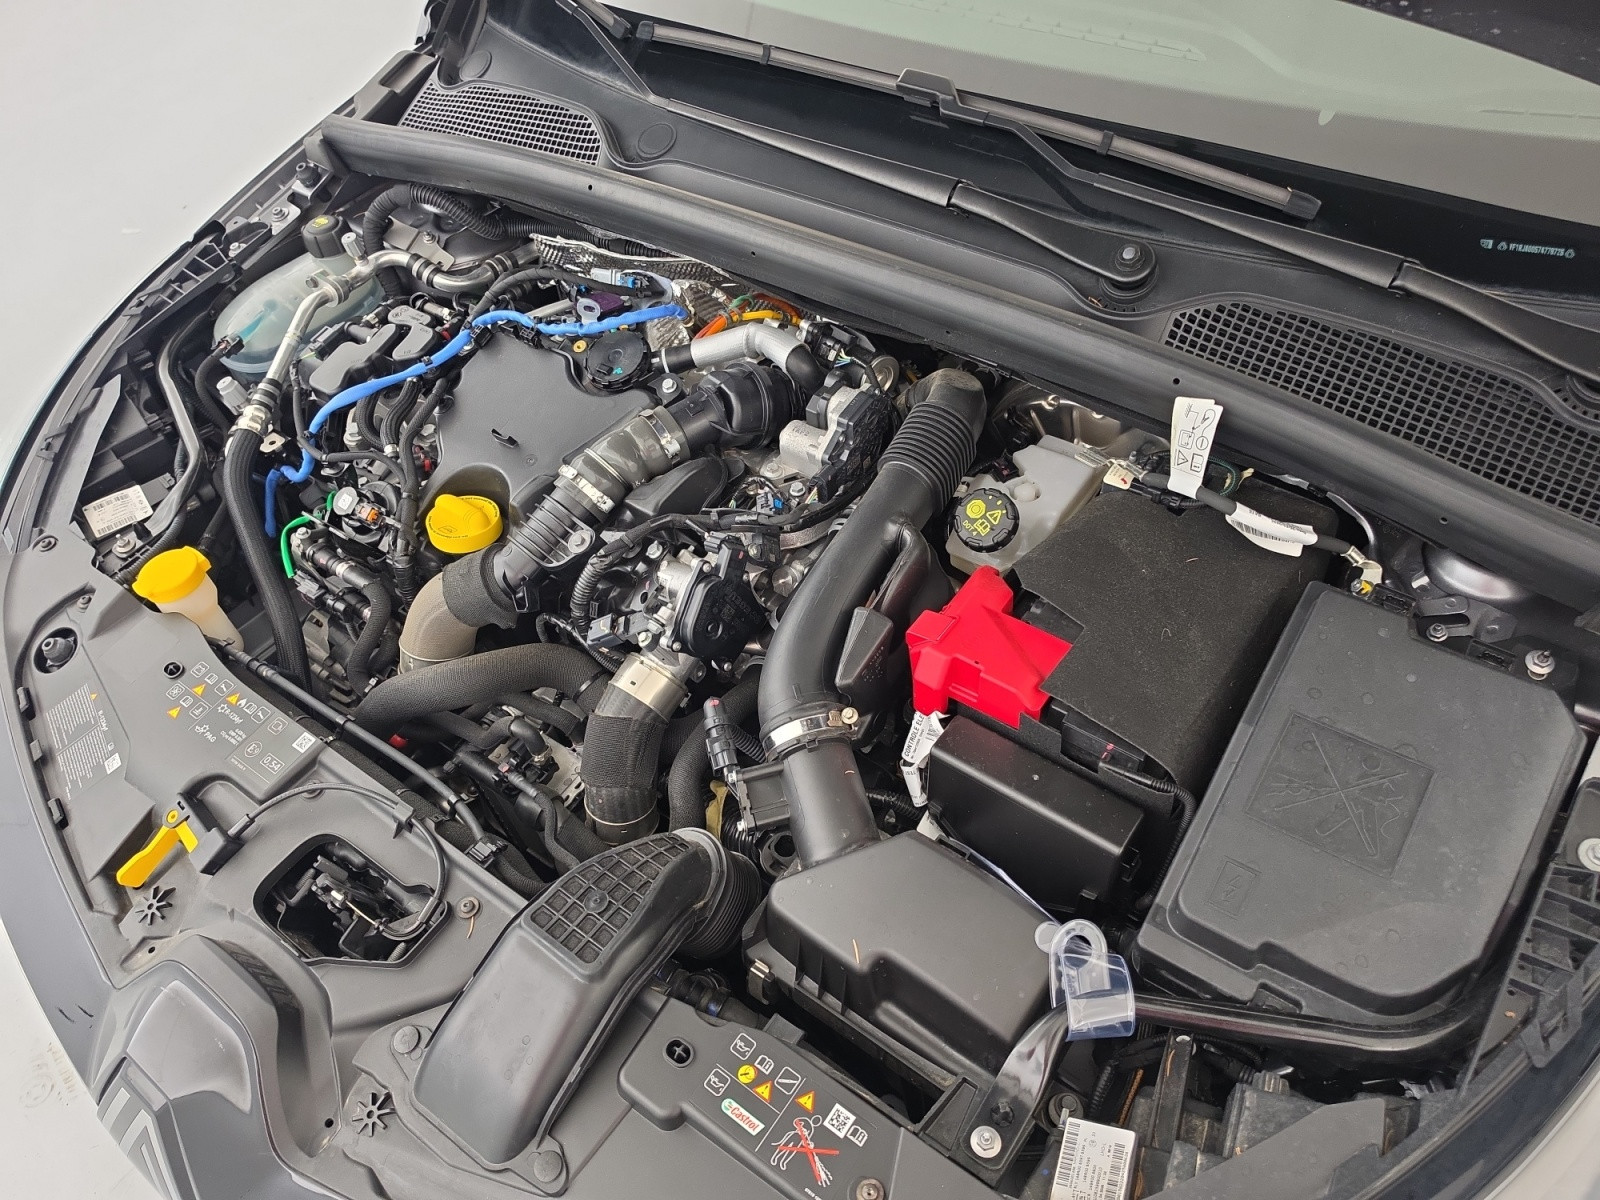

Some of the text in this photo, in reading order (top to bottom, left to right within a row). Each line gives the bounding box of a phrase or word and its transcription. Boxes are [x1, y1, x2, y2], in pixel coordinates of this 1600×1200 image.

[962, 519, 975, 531] DOT
[224, 709, 244, 724] R-1234yf
[203, 731, 217, 743] PAG
[904, 725, 920, 757] CONTROLE
[730, 1105, 760, 1132] Castrol
